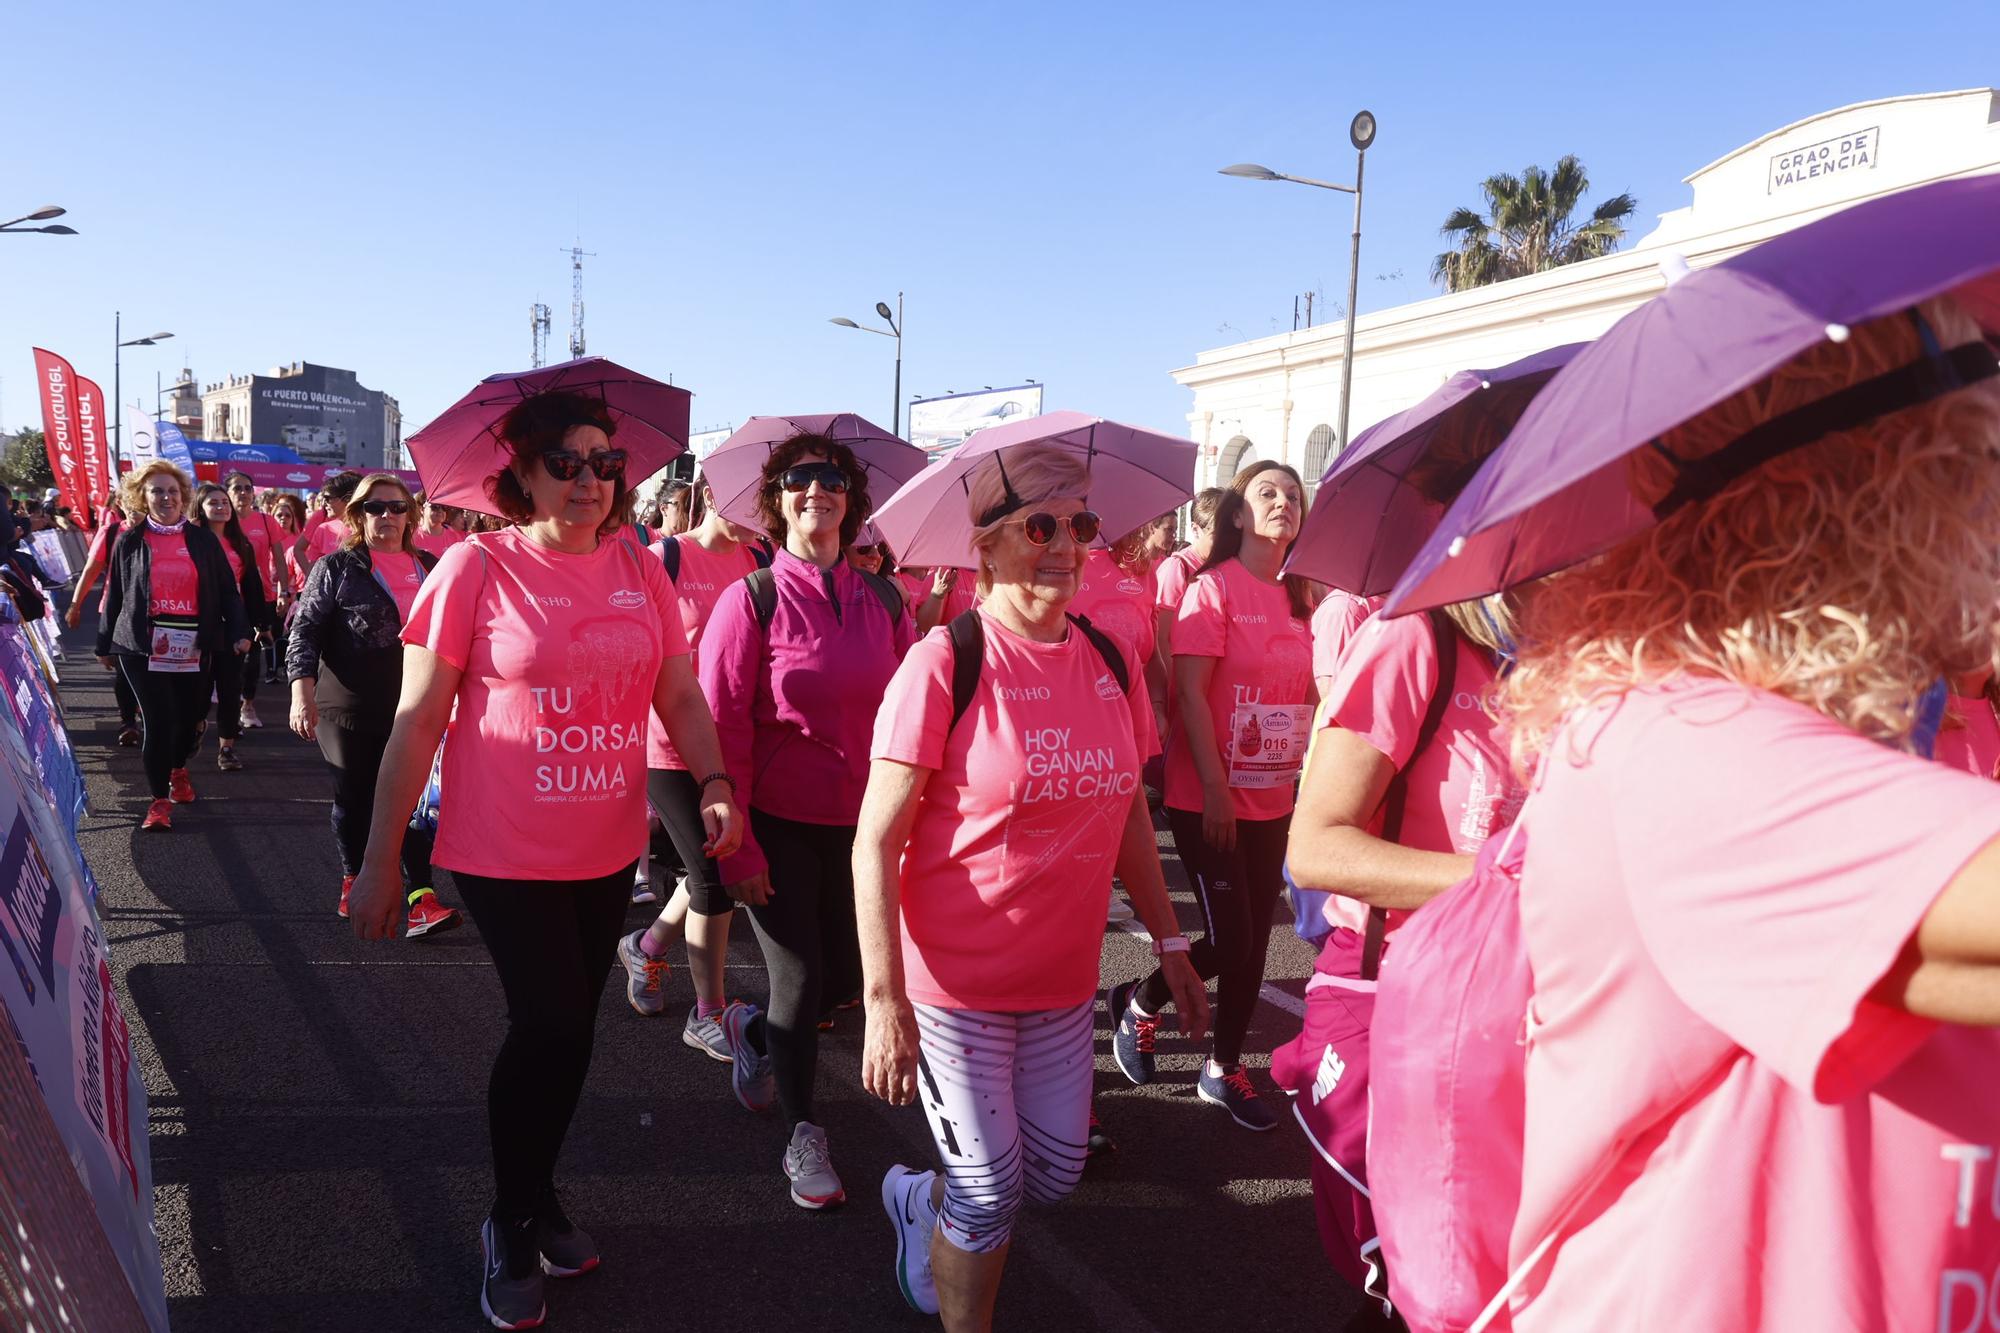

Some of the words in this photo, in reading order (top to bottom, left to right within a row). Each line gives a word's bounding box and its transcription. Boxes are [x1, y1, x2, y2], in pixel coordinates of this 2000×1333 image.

[1780, 146, 1830, 171] GRAO
[1840, 135, 1868, 155] DE
[1775, 151, 1869, 187] VALENCIA
[262, 389, 273, 398] EL
[274, 389, 309, 402] PUERTO
[271, 400, 320, 410] Restaurante
[152, 599, 193, 611] ORSAL
[524, 591, 572, 608] OSHO
[1236, 614, 1268, 625] OYSHO
[530, 687, 572, 714] TU
[998, 686, 1051, 701] OYSHO
[1233, 684, 1261, 706] TU
[1455, 691, 1502, 711] OYS
[535, 721, 645, 753] DORSAL
[1025, 728, 1071, 752] HOY
[1263, 738, 1289, 750] 016
[1026, 748, 1114, 777] GANAN
[1267, 752, 1283, 761] 2235
[535, 761, 627, 792] SUMA
[1237, 775, 1265, 783] OYSHO
[1022, 781, 1069, 804] LAS
[1311, 1043, 1346, 1107] NIKE
[1940, 1143, 2000, 1228] T
